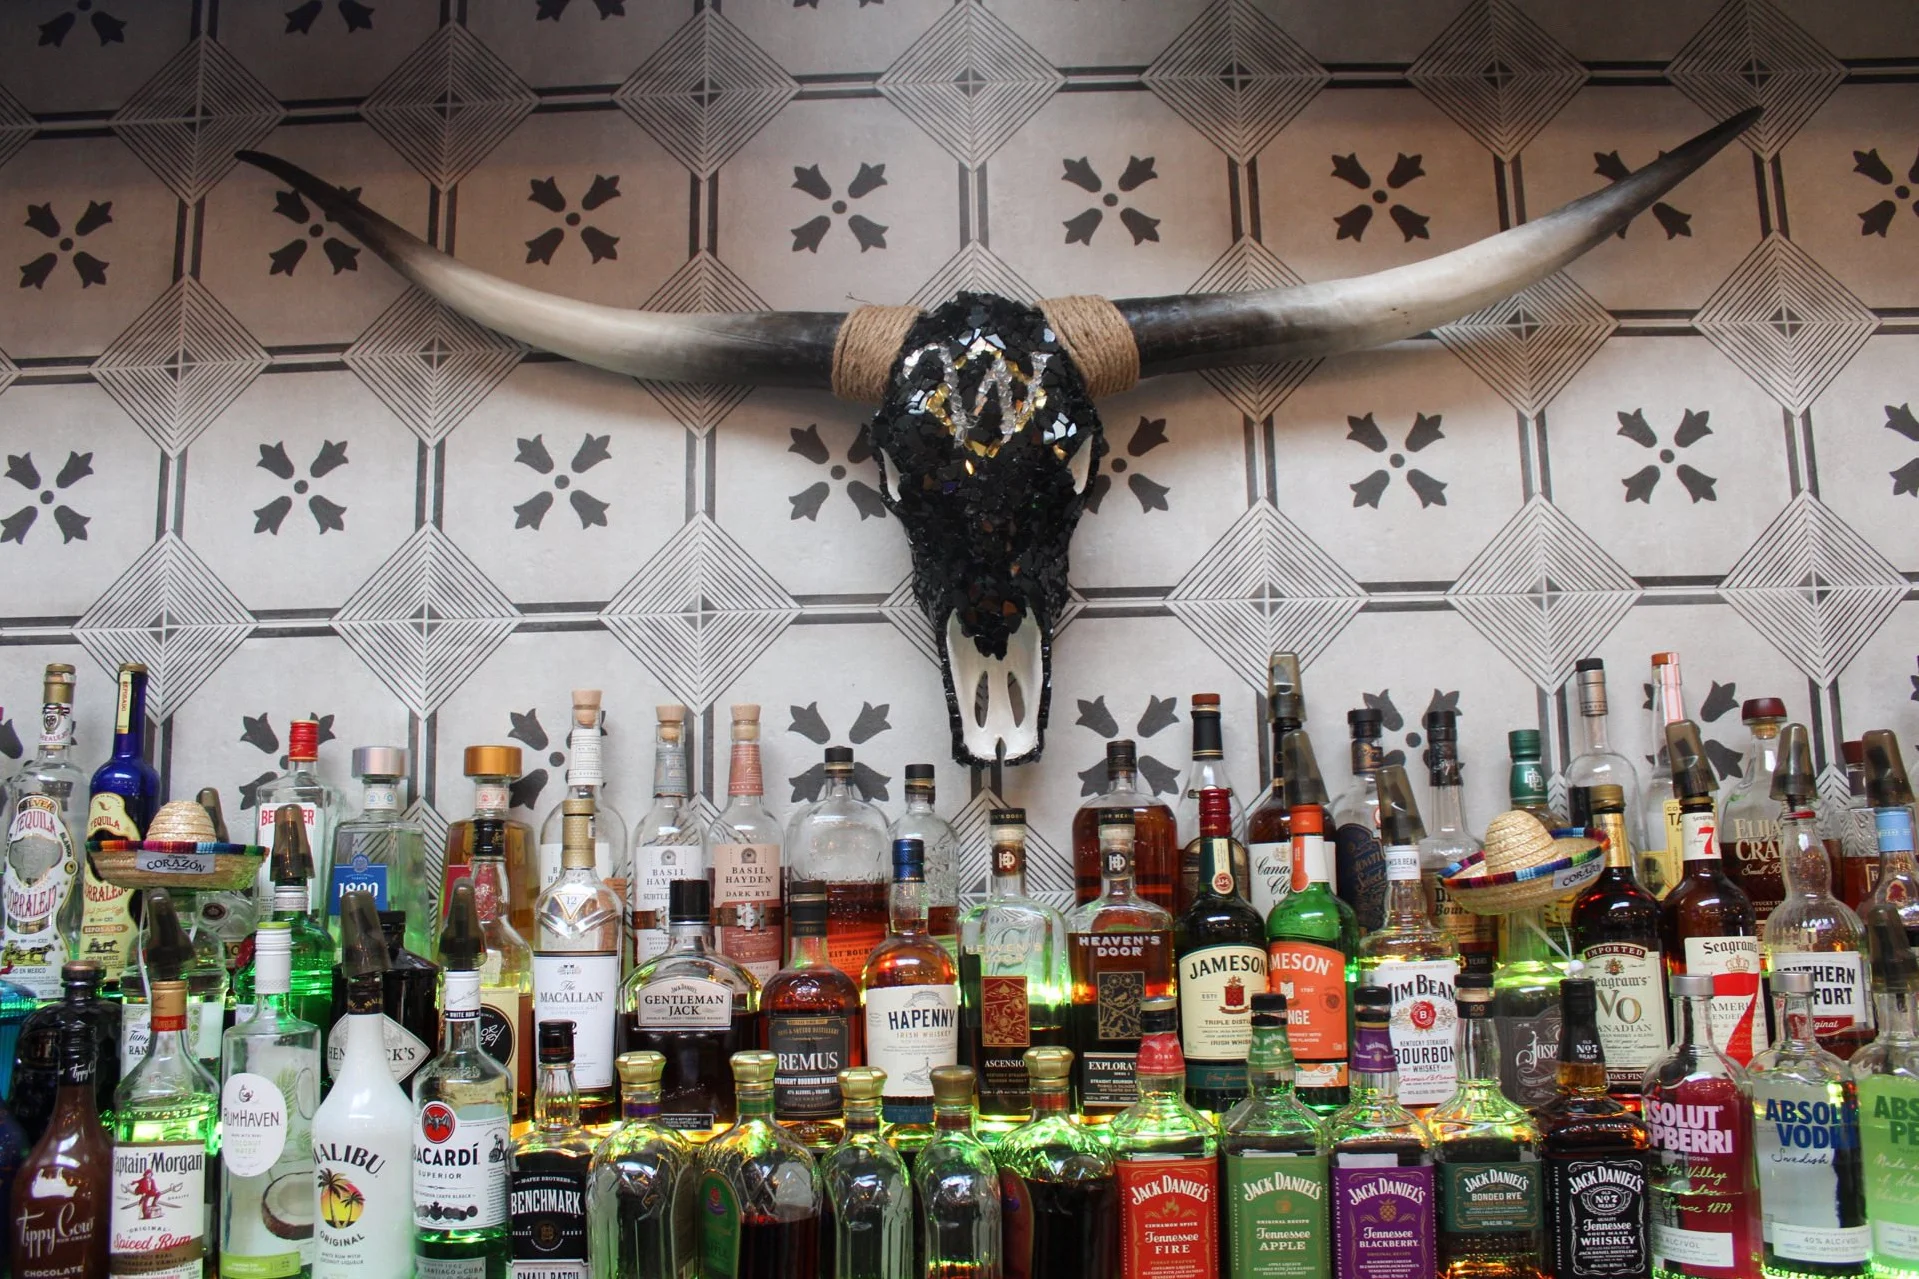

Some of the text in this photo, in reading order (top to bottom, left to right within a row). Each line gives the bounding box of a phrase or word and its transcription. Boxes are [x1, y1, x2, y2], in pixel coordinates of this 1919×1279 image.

[15, 811, 56, 836] TEQUILA
[90, 816, 121, 830] TEQUILA
[1734, 819, 1783, 842] ELIJA
[60, 832, 72, 857] BLANCO
[1697, 826, 1716, 855] 7
[146, 858, 206, 873] CORAZÓN
[732, 867, 766, 875] BASIL
[725, 875, 771, 884] HAYDEN
[84, 882, 129, 902] ORRALEJO
[566, 896, 577, 905] 12
[84, 925, 123, 934] REPOSADO
[1079, 935, 1161, 946] HEAVEN'S
[1097, 947, 1142, 957] DOOR
[1586, 945, 1644, 959] IMPORTED
[1190, 955, 1266, 980] JAMESON
[1270, 952, 1330, 976] MESON
[560, 980, 576, 991] The
[1592, 976, 1648, 989] eagram's
[540, 991, 604, 1003] MACALLAN
[644, 995, 725, 1005] GENTLEMAN
[1813, 987, 1853, 1005] FORT
[669, 1005, 700, 1017] JACK
[1287, 1010, 1311, 1025] NGE
[1420, 1010, 1427, 1019] B
[1598, 1023, 1652, 1032] ANADIAN
[1814, 1019, 1839, 1030] iginal
[897, 1030, 951, 1039] IRISH WHISKEY
[328, 1046, 415, 1062] HENCK'S
[778, 1052, 838, 1071] REMUS
[985, 1059, 1025, 1068] ASCENSIO
[1412, 1064, 1440, 1073] WHISKEY
[774, 1077, 820, 1085] STRAIGHT BOURBON
[1647, 1101, 1719, 1130] SOLUT
[1765, 1099, 1858, 1126] ABSOLU
[1650, 1125, 1733, 1154] PBERRI
[1771, 1147, 1829, 1165] Swedish
[114, 1150, 203, 1177] aptain Morgan
[418, 1170, 462, 1180] SUPERIOR
[541, 1175, 571, 1183] BROTHERS
[1463, 1168, 1530, 1193] JACK DANIEL'S
[1568, 1165, 1645, 1195] JACK DANIEL'S
[1687, 1166, 1728, 1185] Village
[1131, 1174, 1211, 1205] JACK DANIEL'S
[1243, 1171, 1322, 1201] JACK DANIEL'S
[1348, 1177, 1426, 1205] JACK DANIEL'S
[510, 1188, 581, 1216] BENCHMARK
[1471, 1191, 1523, 1201] BONDED RYE
[16, 1202, 95, 1258] Tippy Cow
[129, 1225, 167, 1233] ORIGINAL
[1583, 1218, 1632, 1231] Tennessee
[320, 1230, 365, 1247] ORIGINAL
[1144, 1231, 1199, 1244] Tennessee
[1256, 1227, 1311, 1240] Tennessee
[1364, 1226, 1414, 1239] Tennessee
[113, 1232, 192, 1252] Spiced Rum
[1259, 1241, 1306, 1251] APPLE
[1359, 1239, 1419, 1248] BLACKBERRY
[1580, 1235, 1636, 1246] WHISKEY
[1155, 1244, 1191, 1254] FIRE
[24, 1265, 84, 1278] CHOCOLATE
[463, 1267, 483, 1275] CUBA
